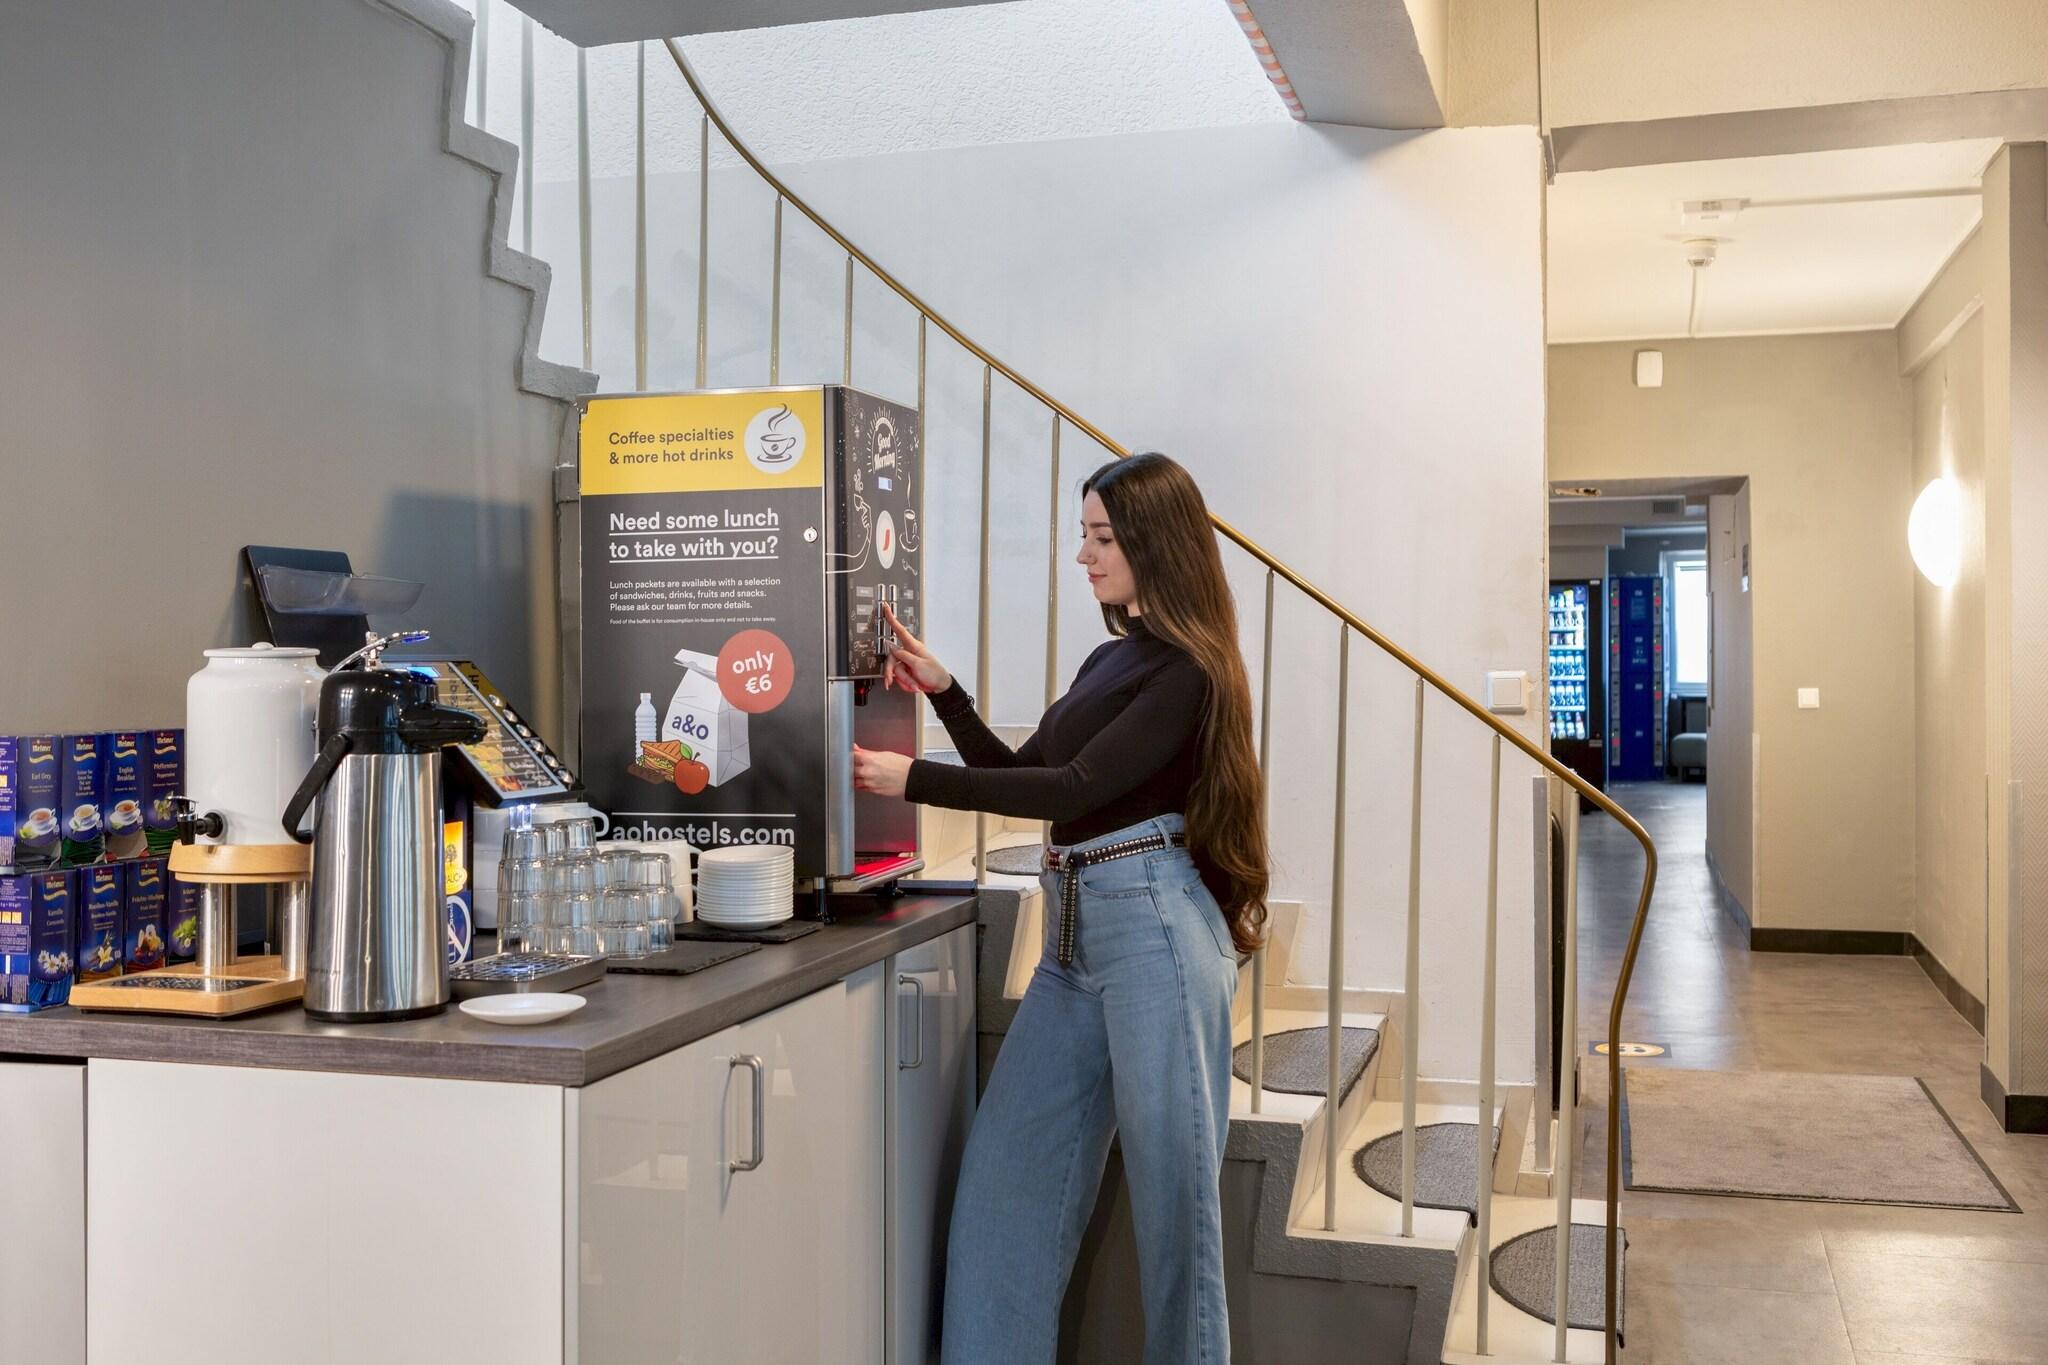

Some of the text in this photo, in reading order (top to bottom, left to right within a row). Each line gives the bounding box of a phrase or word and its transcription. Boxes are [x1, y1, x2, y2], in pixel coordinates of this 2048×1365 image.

[609, 428, 734, 445] Coffee specialties
[609, 448, 734, 464] & more hot drinks
[610, 509, 779, 530] Need some lunch
[610, 536, 778, 558] to take with you?
[610, 580, 633, 589] Lunch
[635, 580, 665, 590] packets
[682, 578, 717, 587] available
[744, 578, 781, 586] selection
[620, 590, 667, 600] sandwiches,
[669, 590, 696, 599] drinks,
[698, 590, 717, 599] fruits
[720, 589, 734, 598] and
[736, 588, 767, 597] snacks.
[610, 602, 634, 611] Please
[724, 600, 752, 609] details.
[732, 651, 774, 674] only
[745, 676, 772, 694] €6
[672, 714, 709, 740] a&o
[612, 820, 795, 845] aohostels.com
